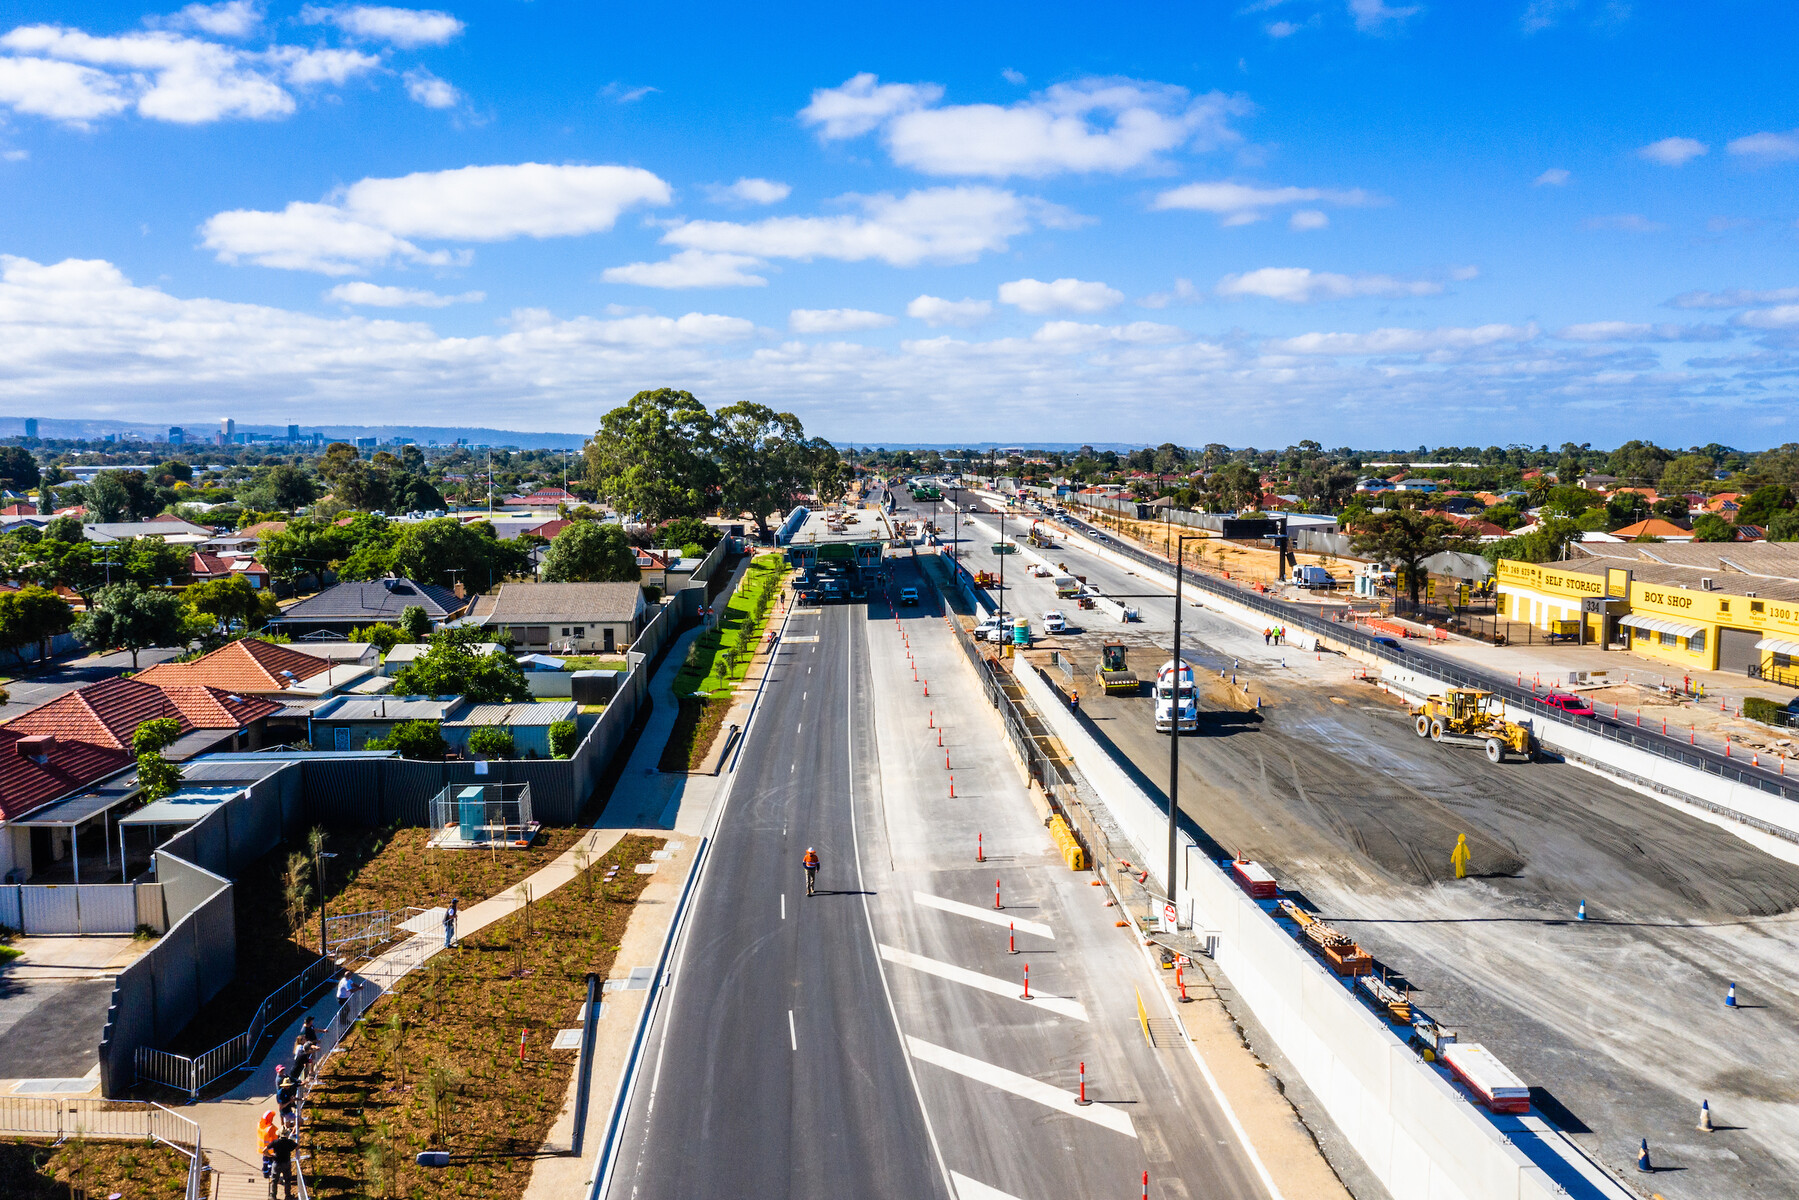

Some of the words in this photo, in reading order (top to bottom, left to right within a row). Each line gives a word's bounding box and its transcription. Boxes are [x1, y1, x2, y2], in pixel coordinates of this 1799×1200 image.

[1545, 575, 1563, 587] SELF
[1566, 578, 1602, 594] STORAGE
[1586, 600, 1600, 612] 334
[1644, 591, 1664, 604] BOX
[1667, 595, 1692, 609] SHOP
[1770, 607, 1791, 619] 1300
